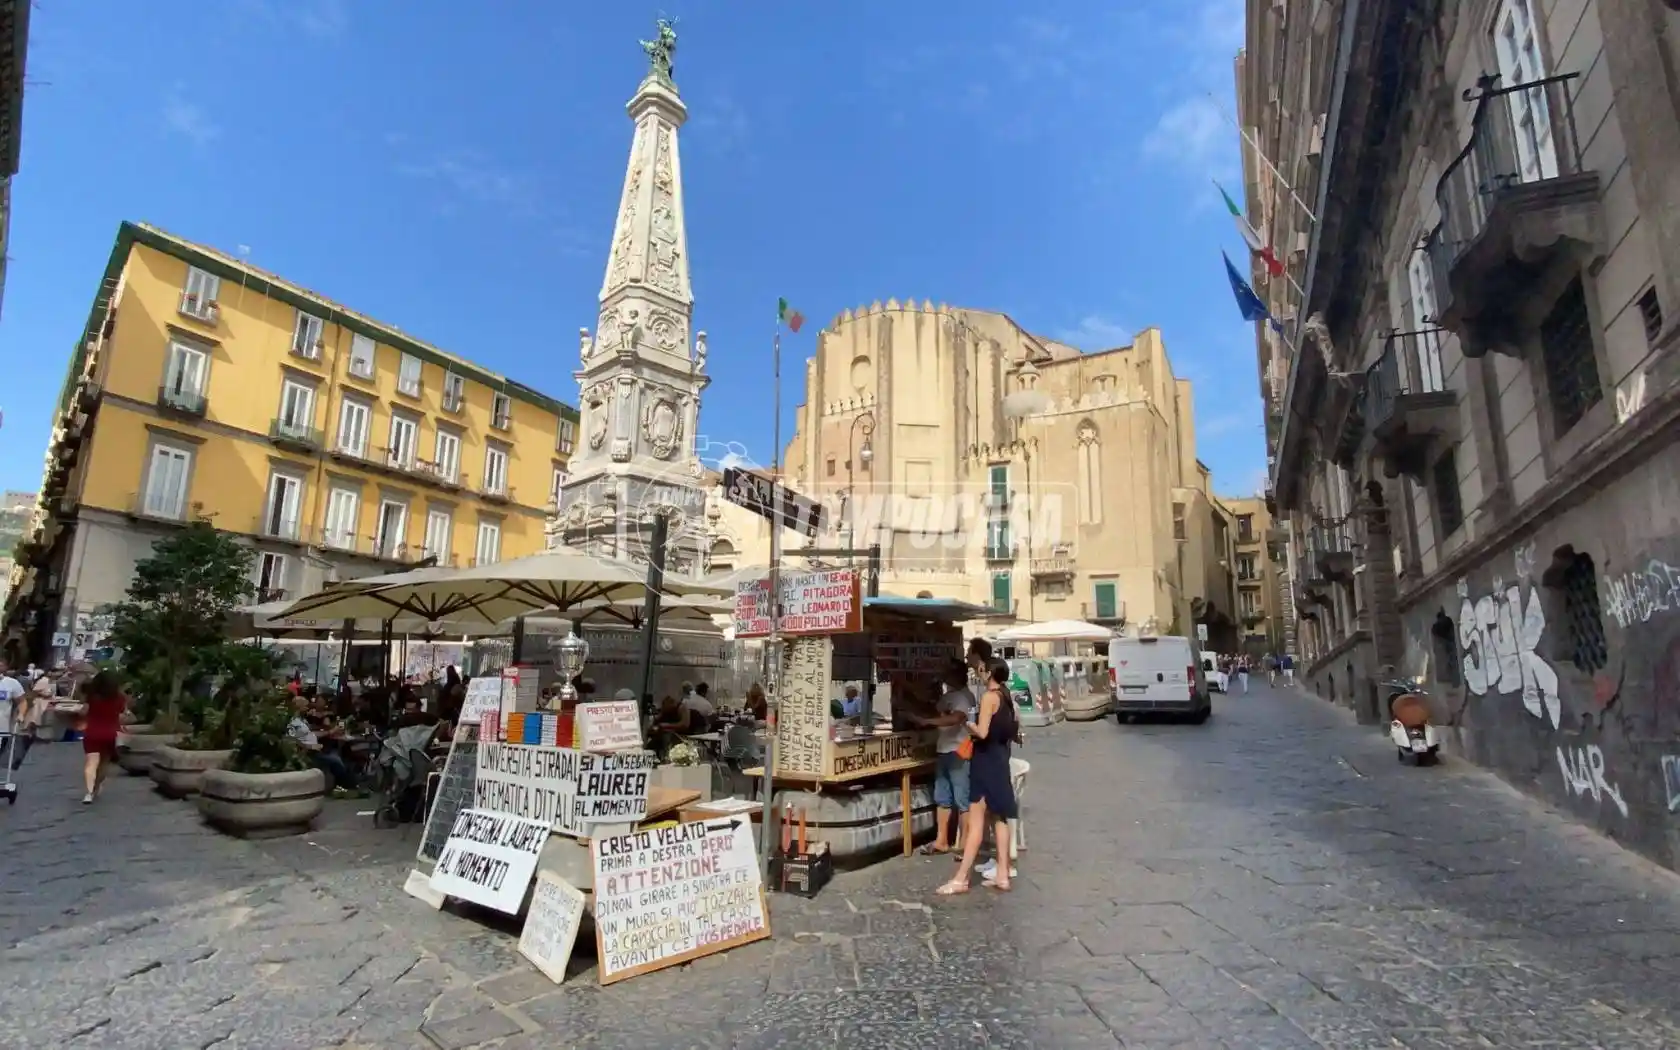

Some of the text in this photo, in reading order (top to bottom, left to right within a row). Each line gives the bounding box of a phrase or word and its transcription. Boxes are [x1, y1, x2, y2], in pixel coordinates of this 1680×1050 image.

[803, 585, 853, 599] PITAGORA
[804, 669, 816, 685] AL
[792, 687, 803, 771] MATEMATICA
[580, 755, 595, 771] SI
[803, 733, 814, 772] UNICA
[834, 752, 880, 776] CONSEGNANO
[476, 777, 530, 819] MATEMATICA
[577, 773, 647, 796] LAUREA
[574, 799, 646, 817] AL MOMENTO
[450, 811, 549, 855] CONSEGNA LAUREE
[600, 821, 706, 857] CRISTO VELATO
[438, 848, 511, 892] AL MOMENTO
[601, 854, 633, 872] PRIMA
[638, 851, 647, 865] A
[606, 854, 722, 897] ATTENZIONE
[640, 884, 677, 906] GIRARE
[682, 882, 690, 894] A
[692, 872, 731, 894] SINISTRA
[603, 920, 618, 936] UN
[625, 911, 658, 932] MURO
[660, 907, 673, 921] SI
[605, 938, 619, 954] LA
[679, 919, 693, 938] IN
[720, 904, 752, 924] CASO
[610, 943, 664, 970] AVANTI
